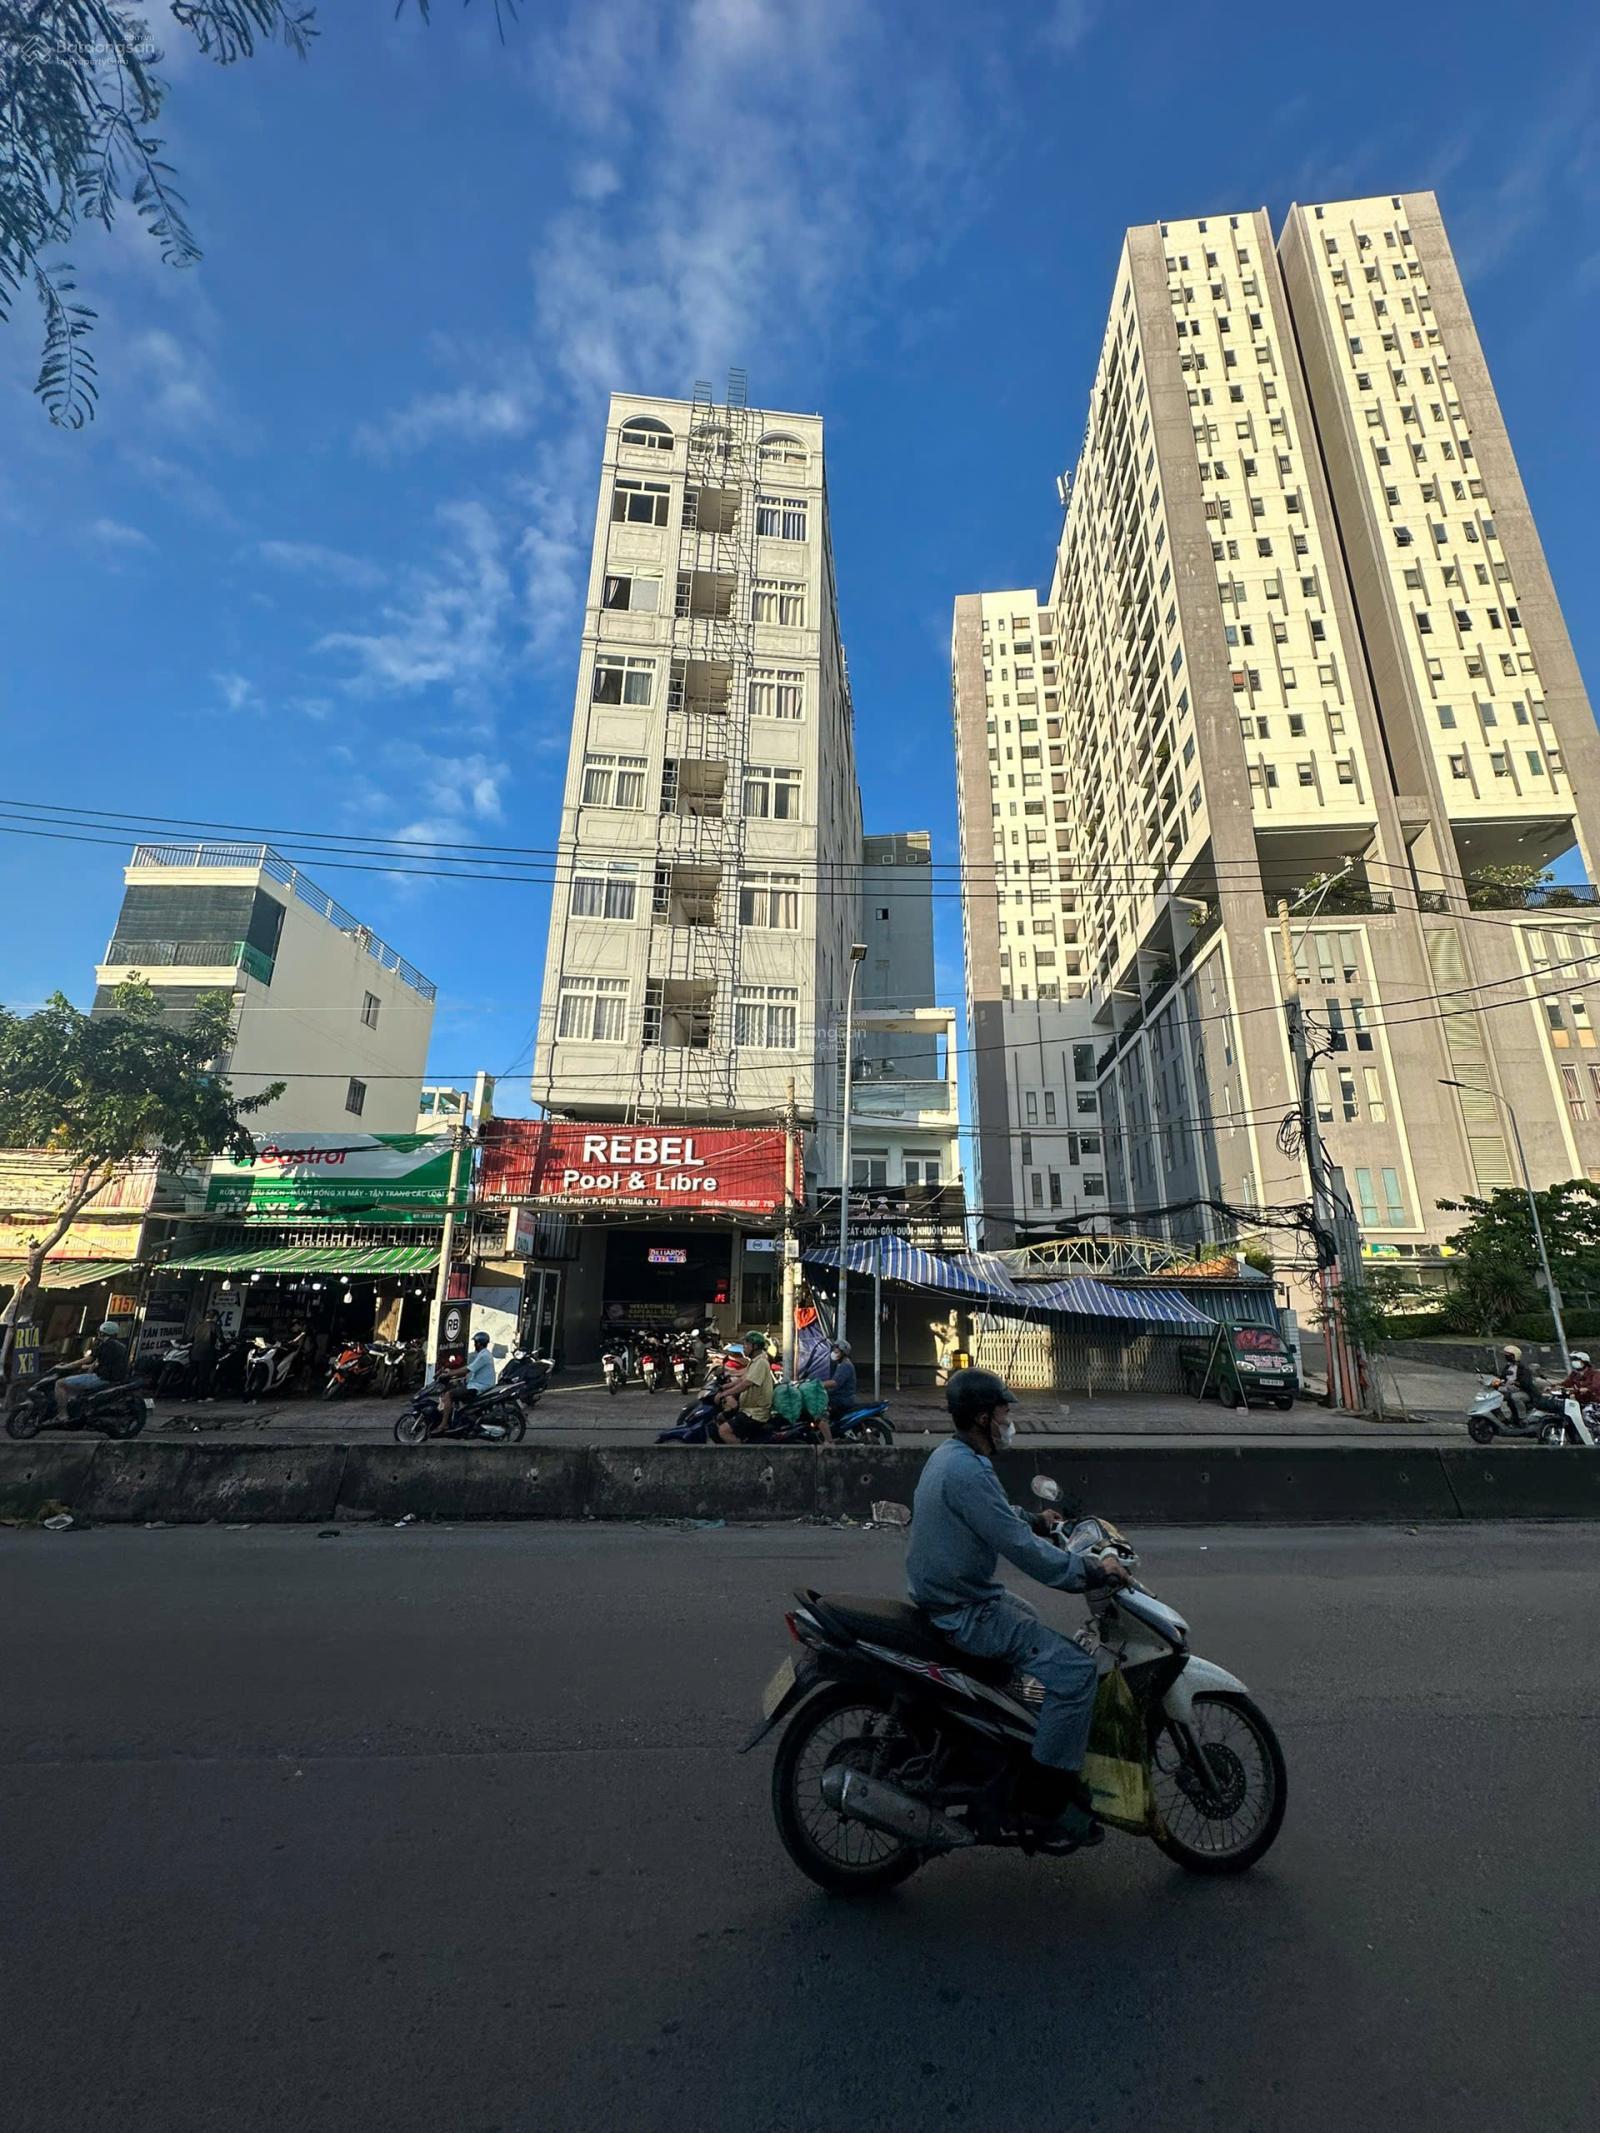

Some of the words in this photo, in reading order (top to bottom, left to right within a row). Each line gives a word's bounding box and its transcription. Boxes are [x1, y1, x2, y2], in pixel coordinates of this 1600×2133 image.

[583, 1135, 704, 1165] REBEL
[563, 1169, 619, 1190] Pool
[628, 1171, 645, 1190] &
[656, 1172, 717, 1191] Libre
[347, 1187, 363, 1197] MÁY
[110, 1296, 136, 1313] 1157
[448, 1319, 459, 1331] RB
[18, 1353, 34, 1375] XE
